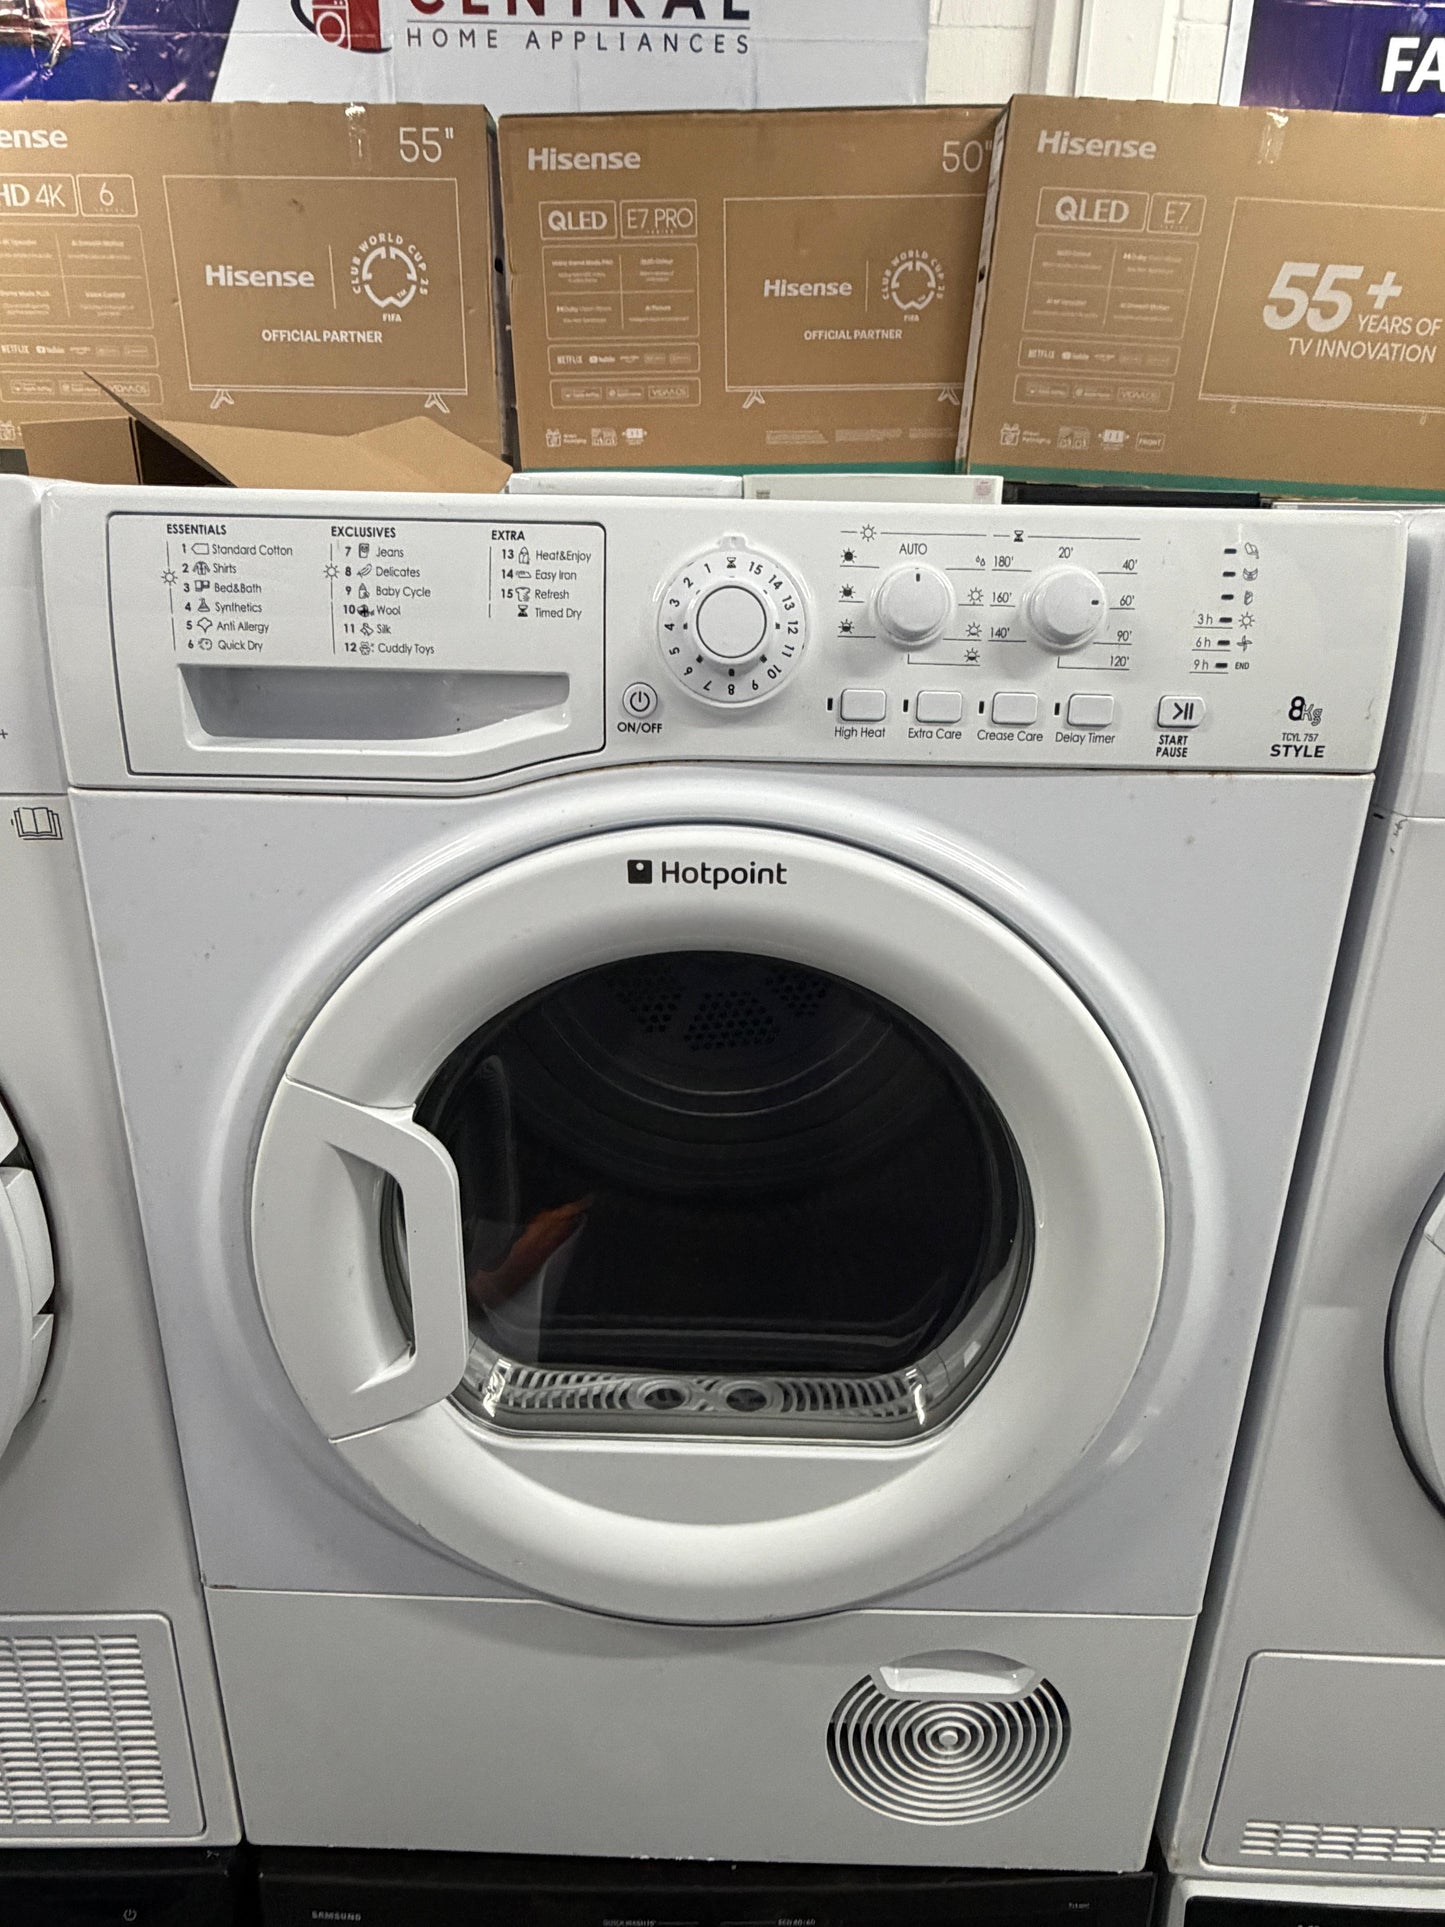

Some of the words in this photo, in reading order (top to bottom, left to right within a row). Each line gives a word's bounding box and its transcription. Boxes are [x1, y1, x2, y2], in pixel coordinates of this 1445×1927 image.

[407, 28, 498, 48] HOME
[525, 30, 749, 54] APPLIANCES
[399, 126, 455, 164] 55"
[1037, 129, 1158, 160] Hisense
[528, 147, 641, 171] Hisense
[942, 140, 993, 173] 50"
[35, 183, 67, 208] 4K
[99, 182, 115, 207] 6
[1055, 195, 1130, 223] QLED
[1163, 201, 1192, 225] E7
[548, 210, 608, 231] QLED
[627, 208, 649, 229] E7
[654, 207, 694, 229] PRO
[350, 256, 361, 294] CLUB
[358, 232, 404, 253] WORLD
[407, 244, 427, 271] CUP
[891, 249, 929, 267] WORLD
[930, 258, 945, 280] CUP
[205, 264, 315, 288] Hisense
[763, 279, 853, 298] Hisense
[382, 312, 402, 322] FIFA
[1356, 314, 1412, 335] YEARS
[1415, 317, 1441, 337] OF
[261, 329, 321, 343] OFFICIAL
[322, 330, 383, 344] PARTNER
[803, 329, 853, 341] OFFICIAL
[853, 328, 903, 340] PARTNER
[1288, 337, 1314, 357] TV
[1315, 338, 1438, 364] INNOVATION
[167, 524, 227, 536] ESSENTIALS
[331, 526, 396, 538] EXCLUSIVES
[491, 530, 525, 541] EXTRA
[182, 543, 187, 554] 1
[212, 544, 257, 556] Standard
[259, 545, 293, 556] Cotton
[345, 547, 352, 556] 7
[375, 546, 404, 558] Jeans
[899, 543, 928, 556] AUTO
[501, 549, 515, 560] 13
[535, 550, 592, 564] Heat&Enjoy
[182, 563, 189, 573] 2
[213, 563, 237, 574] Shirts
[345, 567, 352, 577] 8
[375, 566, 421, 578] Delicates
[704, 562, 712, 573] 1
[748, 561, 764, 575] 15
[501, 569, 514, 579] 14
[535, 569, 557, 582] Easy
[558, 570, 578, 581] Iron
[768, 574, 783, 590] 14
[183, 583, 190, 593] 3
[214, 582, 262, 594] Bed&Bath
[683, 577, 694, 588] 2
[345, 586, 352, 596] 9
[375, 586, 401, 599] Baby
[402, 586, 431, 599] Cycle
[501, 588, 514, 599] 15
[534, 589, 570, 600] Refresh
[184, 602, 192, 612] 4
[214, 601, 263, 614] Synthetics
[669, 598, 680, 607] 3
[781, 595, 796, 611] 13
[343, 605, 356, 615] 10
[376, 604, 402, 616] Wool
[534, 607, 564, 619] Timed
[565, 608, 583, 621] Dry
[186, 621, 193, 630] 5
[216, 620, 236, 632] Anti
[236, 621, 270, 634] Allergy
[343, 623, 355, 634] 11
[376, 623, 392, 635] Silk
[664, 623, 675, 632] 4
[787, 620, 799, 635] 12
[187, 639, 195, 650] 6
[217, 639, 246, 651] Quick
[246, 640, 263, 653] Dry
[344, 642, 357, 652] 12
[377, 642, 413, 655] Cuddly
[413, 643, 435, 656] Toys
[669, 646, 680, 655] 5
[781, 644, 795, 658] 11
[683, 666, 693, 676] 6
[767, 664, 782, 680] 10
[1234, 661, 1250, 670] END
[703, 680, 713, 691] 7
[728, 684, 735, 696] 8
[751, 679, 759, 691] 9
[617, 721, 663, 735] ON/OFF
[834, 726, 858, 740] High
[860, 726, 886, 738] Heat
[908, 728, 933, 740] Extra
[935, 728, 962, 740] Care
[977, 730, 1014, 742] Crease
[1017, 731, 1044, 742] Care
[1055, 732, 1086, 745] Delay
[1088, 732, 1116, 744] Timer
[1158, 735, 1188, 746] START
[1281, 732, 1302, 742] TCYL
[1303, 733, 1319, 743] 757
[1155, 747, 1188, 758] PAUSE
[1270, 744, 1326, 759] STYLE
[661, 861, 788, 890] Hotpoint
[311, 1910, 362, 1921] SAMSUNG
